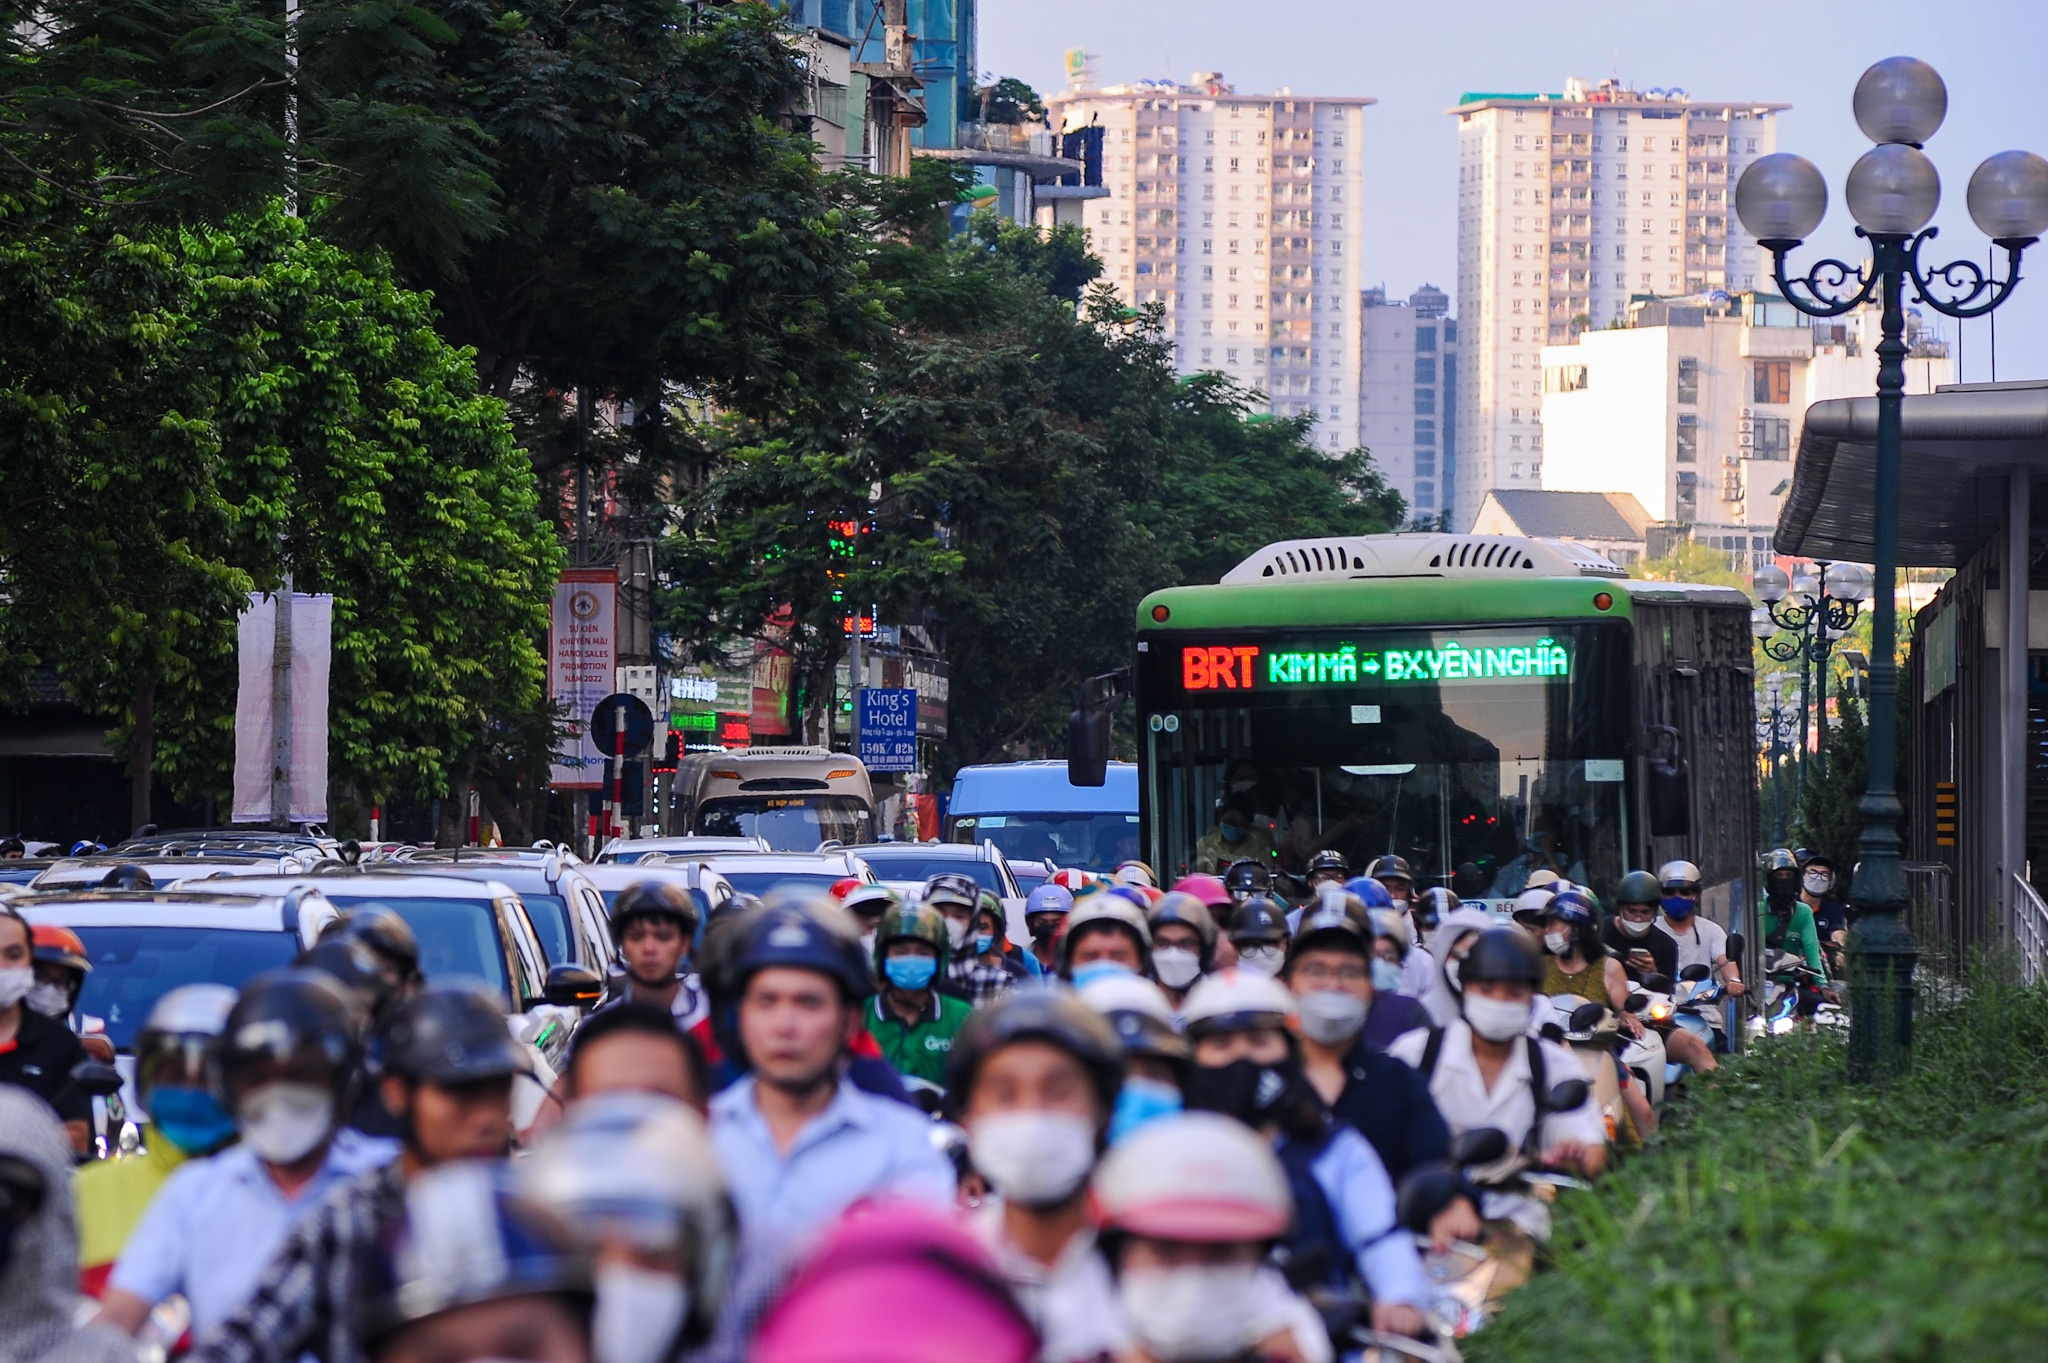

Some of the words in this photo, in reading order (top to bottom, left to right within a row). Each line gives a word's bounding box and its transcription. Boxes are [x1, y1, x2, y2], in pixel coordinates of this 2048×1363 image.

[585, 650, 609, 658] SALES
[1269, 652, 1316, 683] KIM
[1318, 643, 1357, 683] MÃ
[1484, 638, 1568, 677] NGHĨA
[560, 662, 607, 670] PROMOTION
[1183, 646, 1260, 689] BRT
[584, 675, 603, 683] 2022
[867, 690, 910, 711] King's
[868, 710, 907, 726] Hotel
